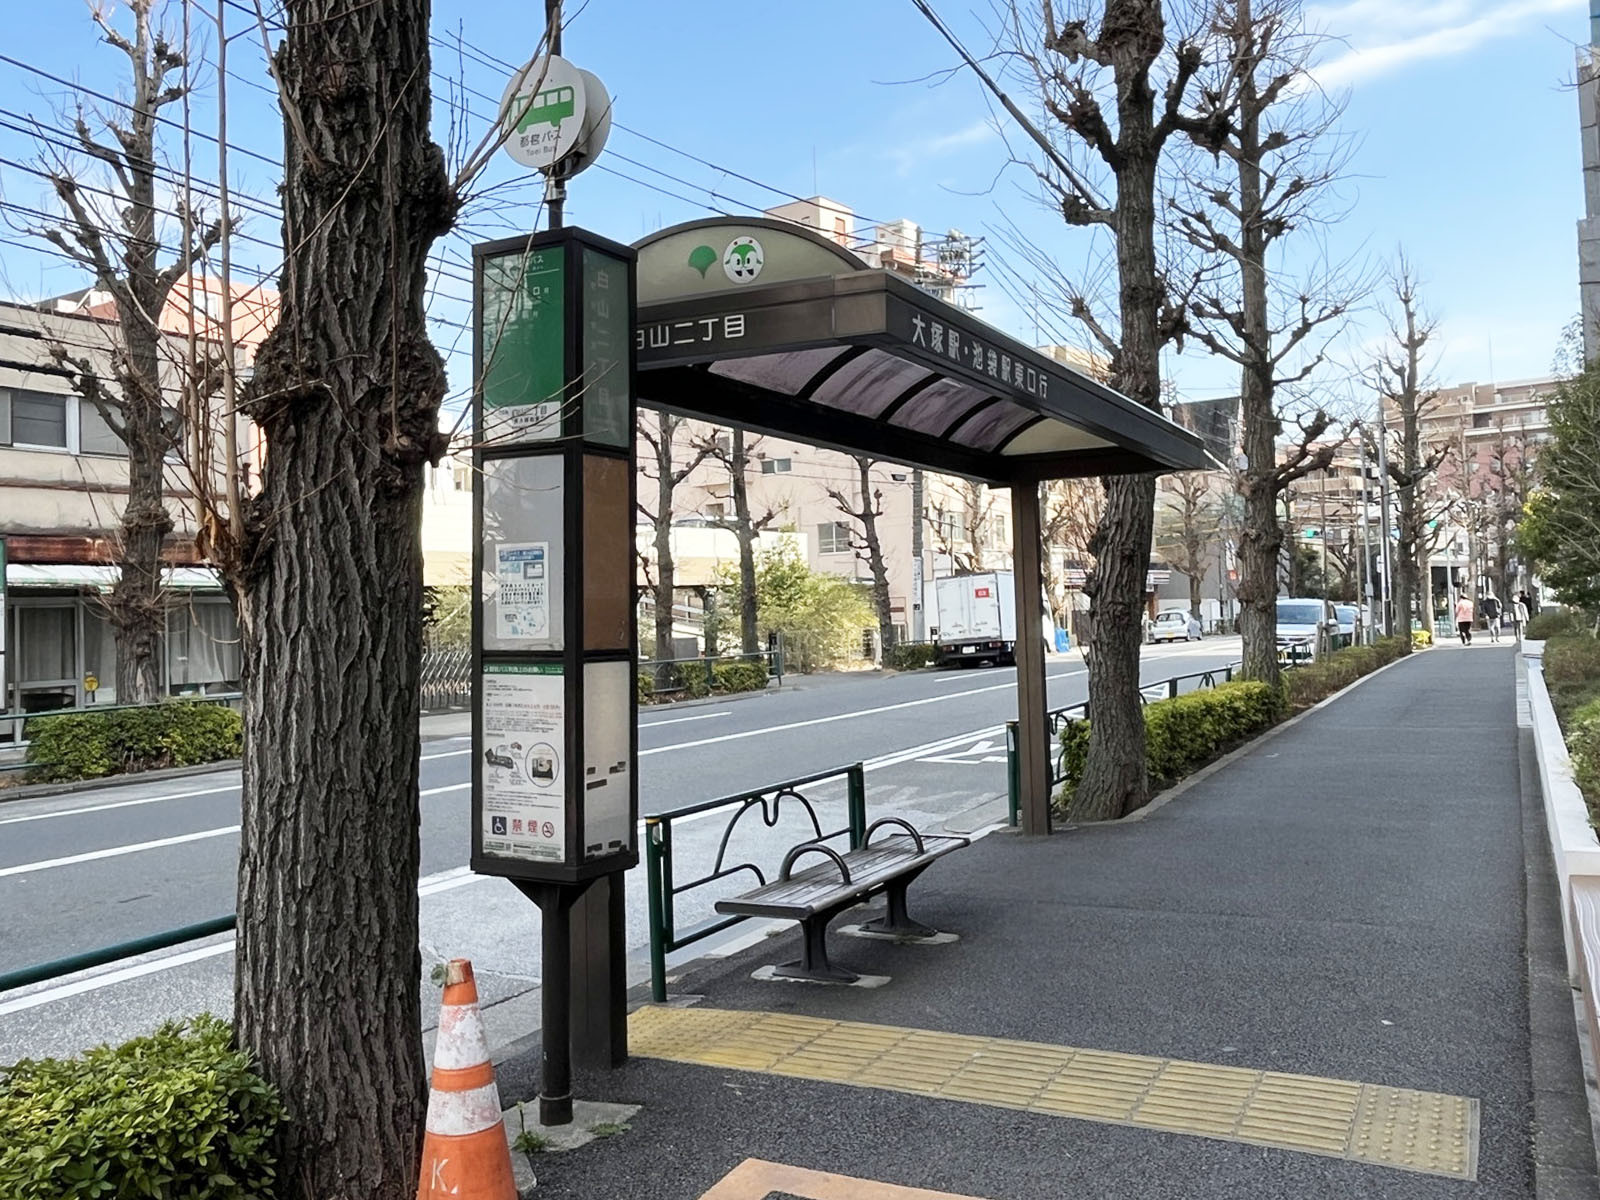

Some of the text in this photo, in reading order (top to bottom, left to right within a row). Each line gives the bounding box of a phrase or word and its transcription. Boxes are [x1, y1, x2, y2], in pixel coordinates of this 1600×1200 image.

[912, 313, 1048, 400] 大塚駅・池袋駅東口行
